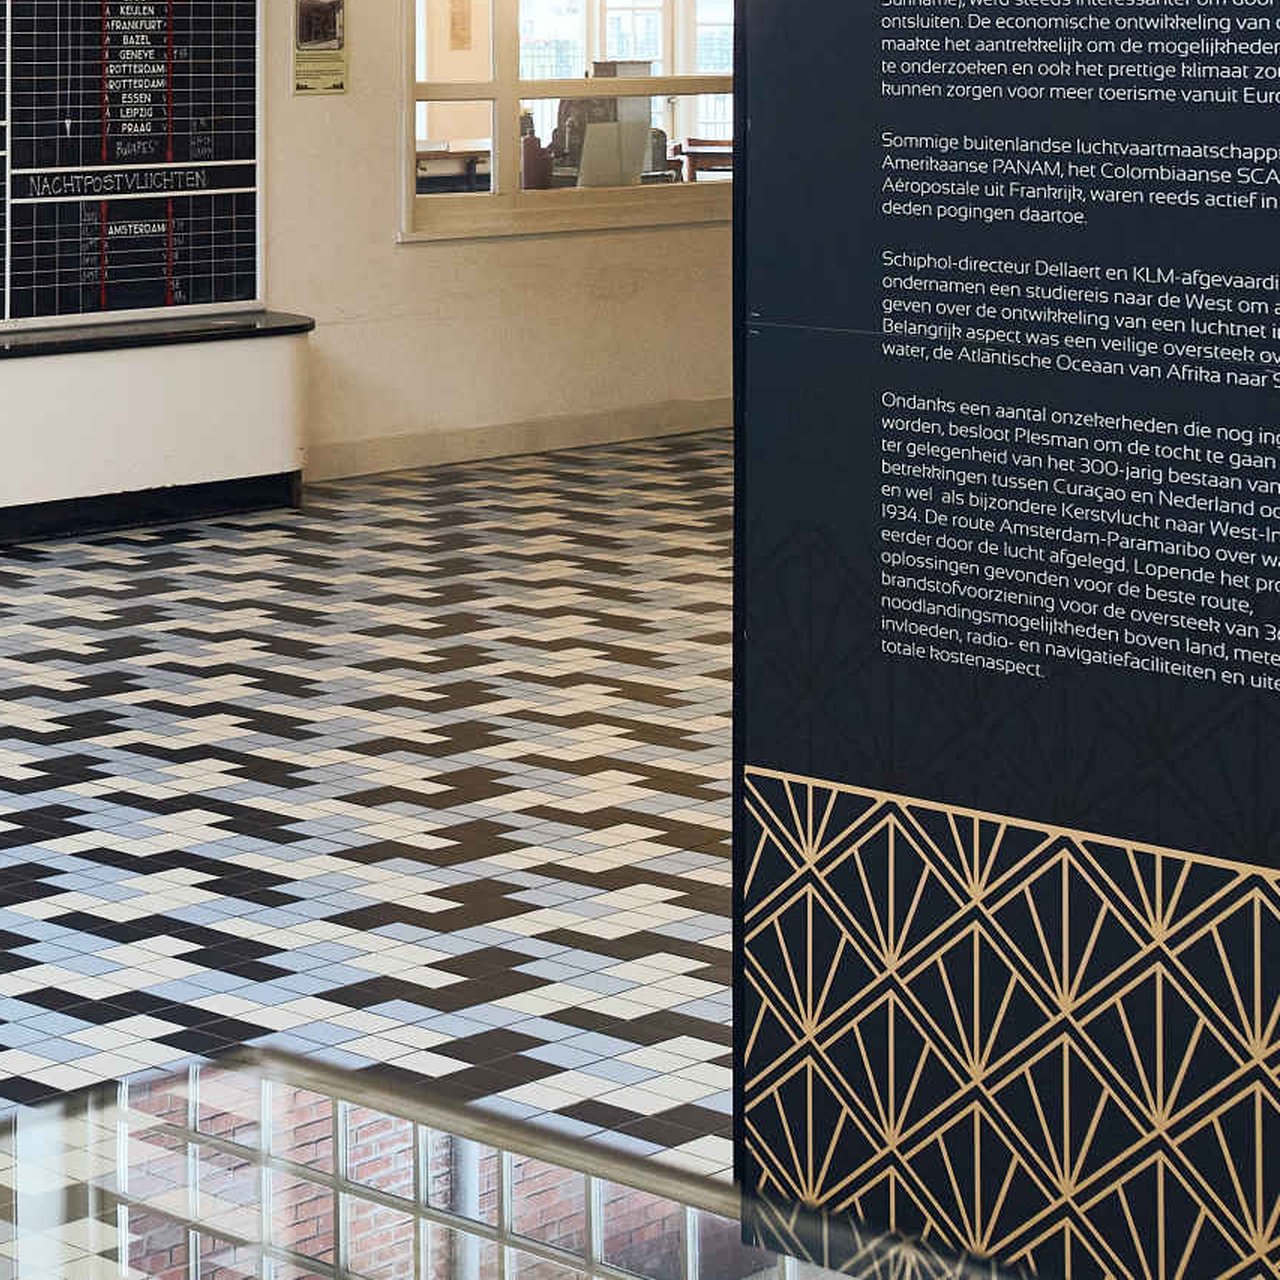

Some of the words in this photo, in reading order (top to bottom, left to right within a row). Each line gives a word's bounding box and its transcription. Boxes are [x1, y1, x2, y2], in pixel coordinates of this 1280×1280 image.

[881, 131, 959, 153] Sommige
[963, 134, 1072, 153] buitenlandse
[881, 249, 1031, 275] Schiphol-directeur
[1034, 259, 1101, 280] Dellaert
[1105, 267, 1128, 281] en
[881, 638, 926, 659] totale
[929, 644, 1045, 678] kostenaspect.
